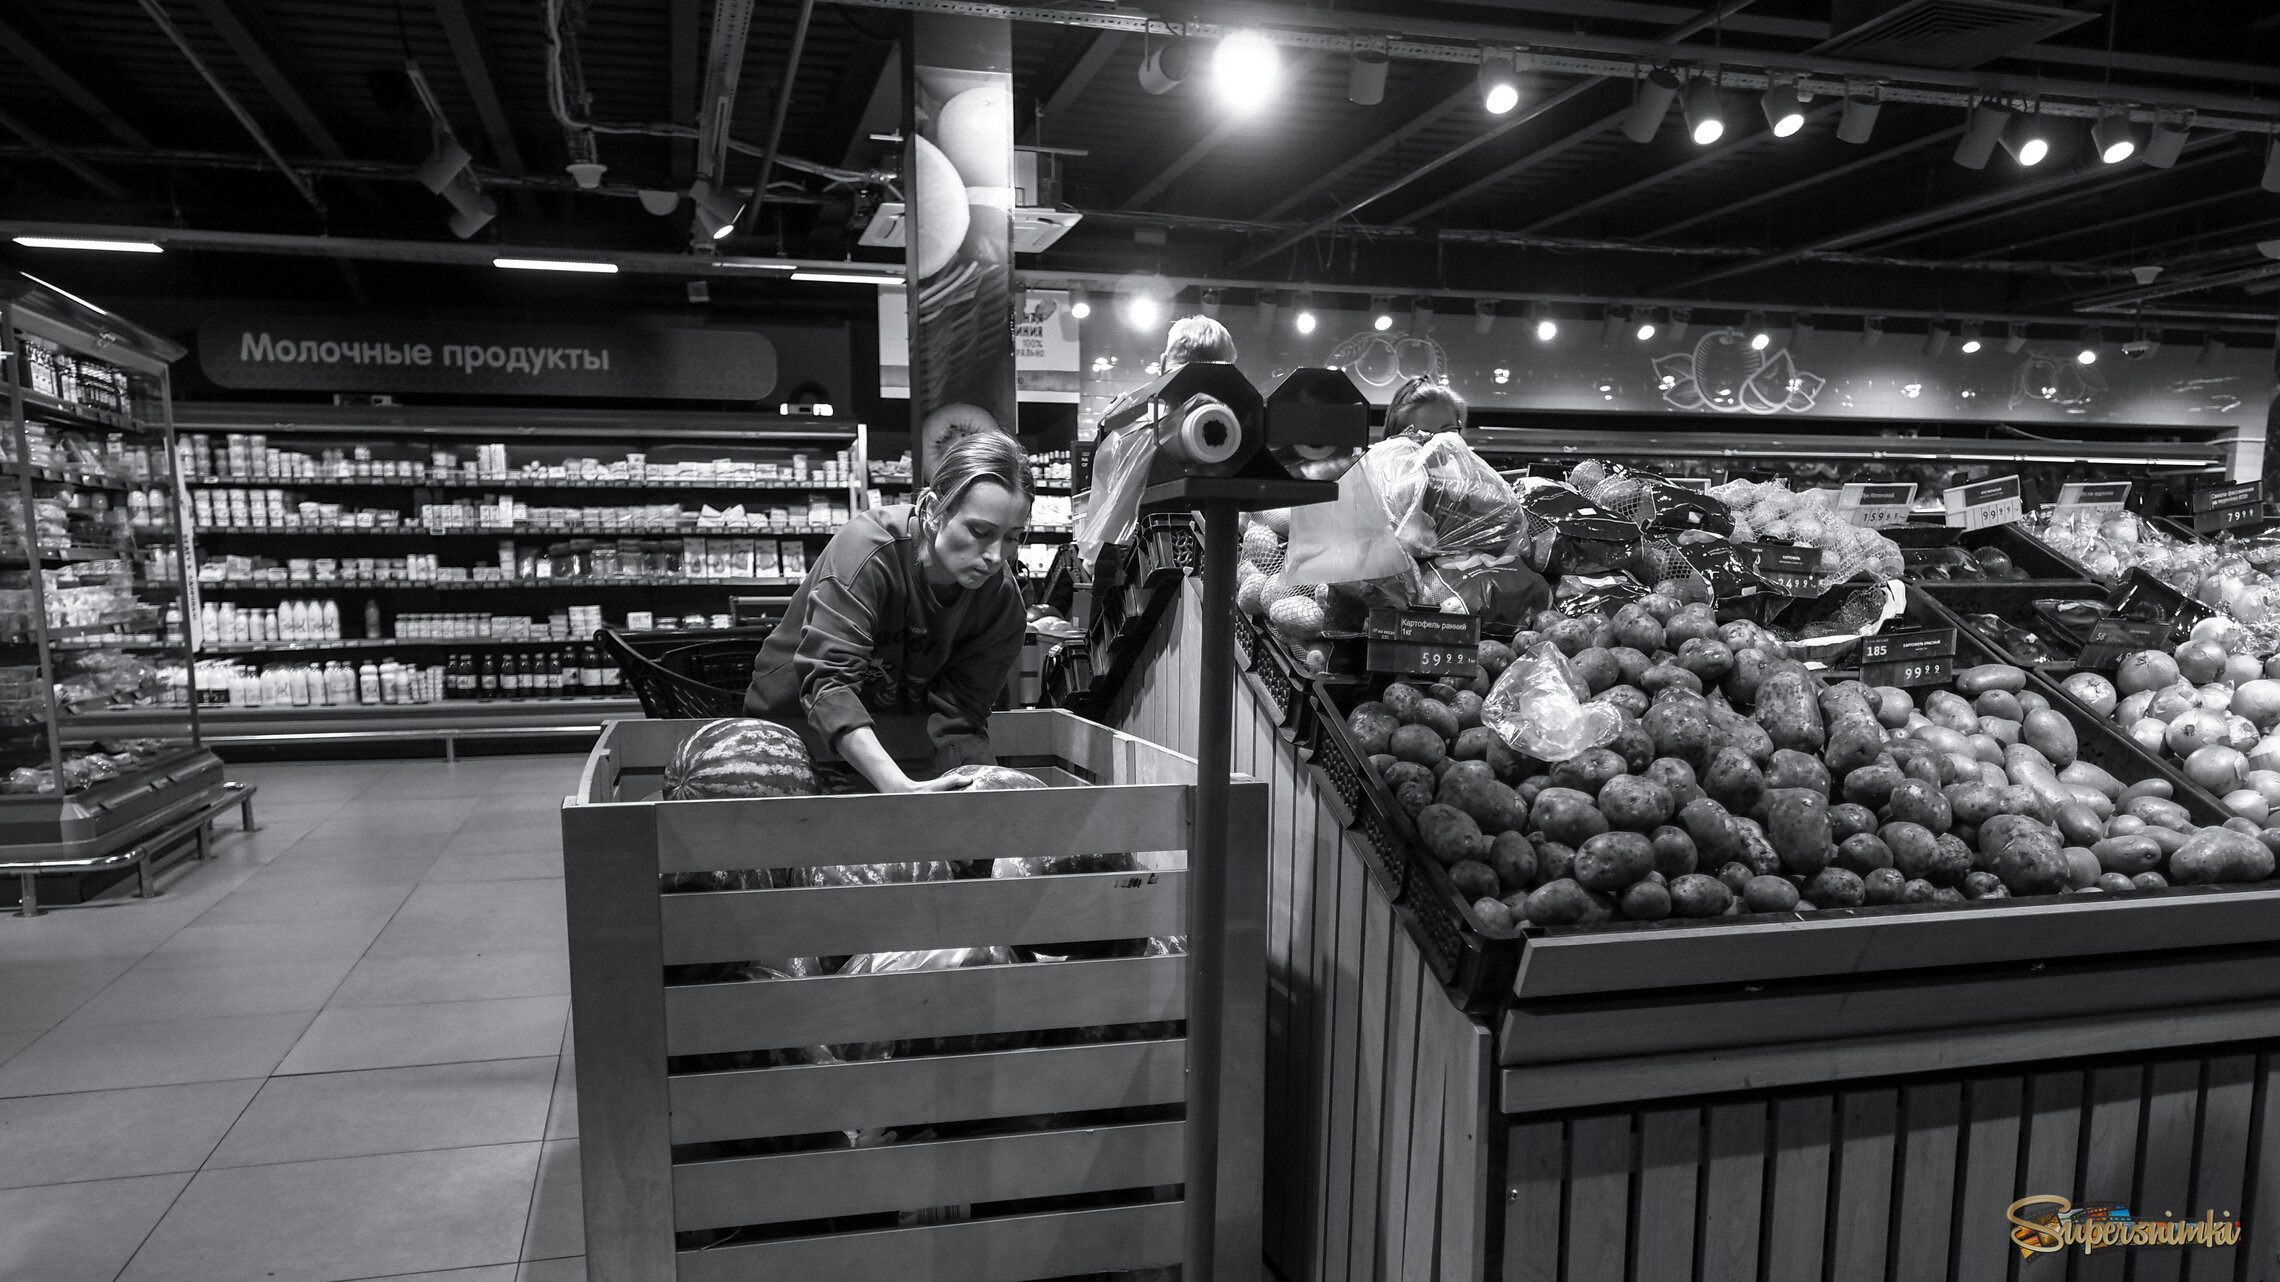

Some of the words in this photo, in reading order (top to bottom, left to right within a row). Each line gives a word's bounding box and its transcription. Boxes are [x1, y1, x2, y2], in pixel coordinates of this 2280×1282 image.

[1015, 326, 1043, 337] ИНИЯ
[240, 332, 433, 365] Молочные
[442, 344, 610, 376] продукты
[1015, 348, 1045, 357] РАЛЬНО
[1401, 618, 1441, 630] Картофель
[1441, 621, 1467, 631] ранний
[1402, 628, 1413, 636] 1кг
[1866, 645, 1888, 657] 185
